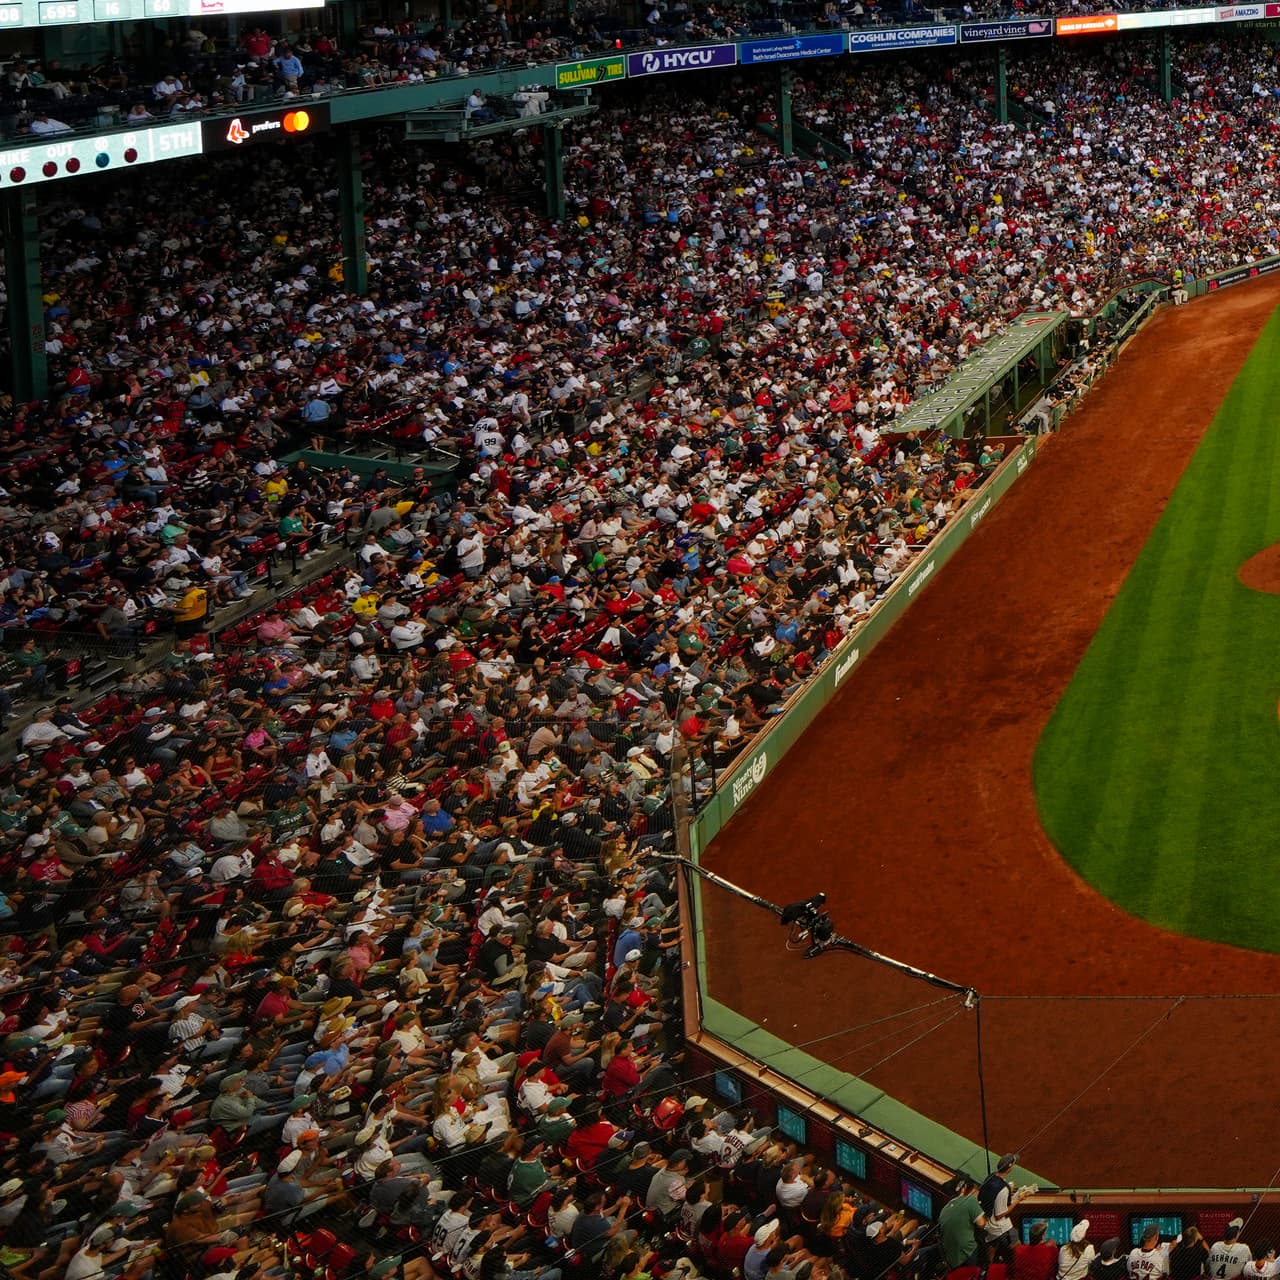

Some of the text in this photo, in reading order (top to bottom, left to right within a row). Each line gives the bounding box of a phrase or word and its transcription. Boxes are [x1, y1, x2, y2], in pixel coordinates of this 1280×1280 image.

[42, 5, 77, 19] .695
[105, 2, 119, 15] 16
[153, 0, 170, 13] 60
[1235, 8, 1259, 17] AMAZING
[851, 32, 897, 44] COGHLIN
[898, 28, 955, 40] COMPANIES
[964, 26, 1026, 38] vineyard vines
[664, 50, 713, 68] HYCU
[559, 63, 623, 85] SULLIVAN TIRE
[252, 121, 281, 134] prefers
[159, 132, 193, 151] 5TH
[46, 144, 74, 157] OUT
[434, 1226, 447, 1248] 99
[1211, 1253, 1239, 1264] GEHRIG
[1130, 1259, 1156, 1272] BIG PAPI
[1216, 1265, 1226, 1278] 4
